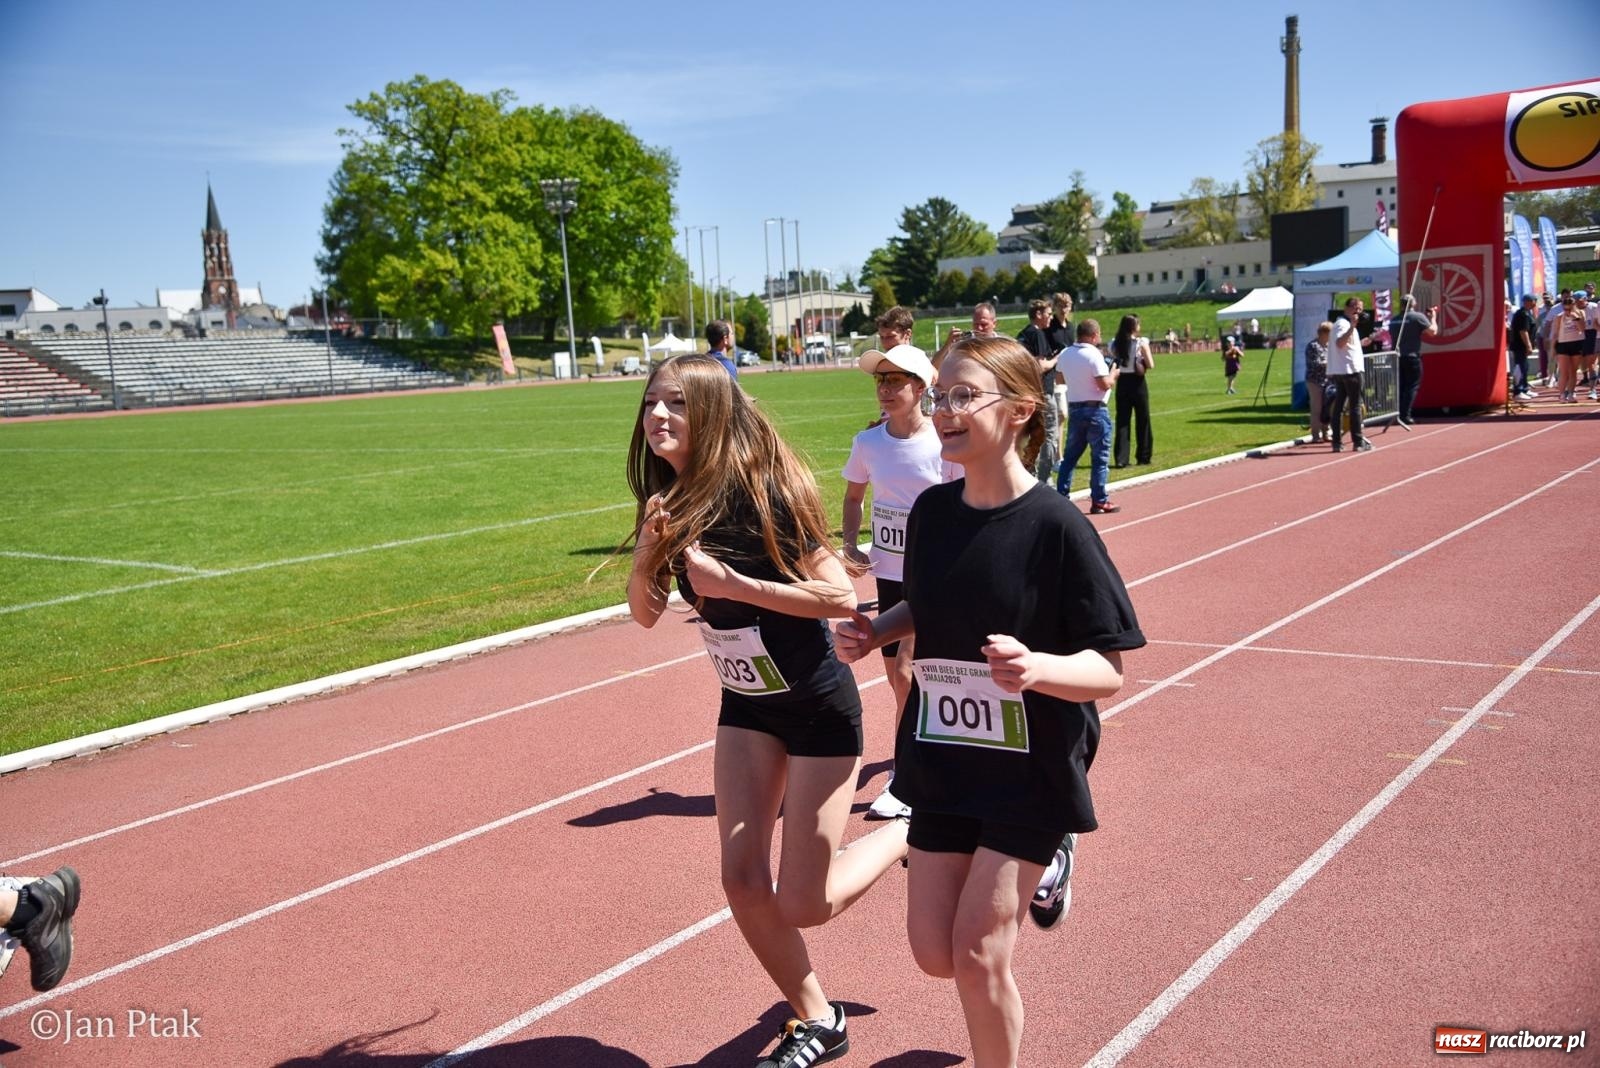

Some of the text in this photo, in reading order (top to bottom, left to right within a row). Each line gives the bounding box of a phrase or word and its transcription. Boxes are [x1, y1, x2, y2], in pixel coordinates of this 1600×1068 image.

[881, 526, 904, 547] 011
[714, 653, 756, 683] 003
[920, 665, 938, 673] XVIII
[938, 666, 955, 675] BIEG
[956, 666, 968, 676] BEZ
[923, 673, 962, 685] 3MAJA2026
[938, 695, 993, 732] 001
